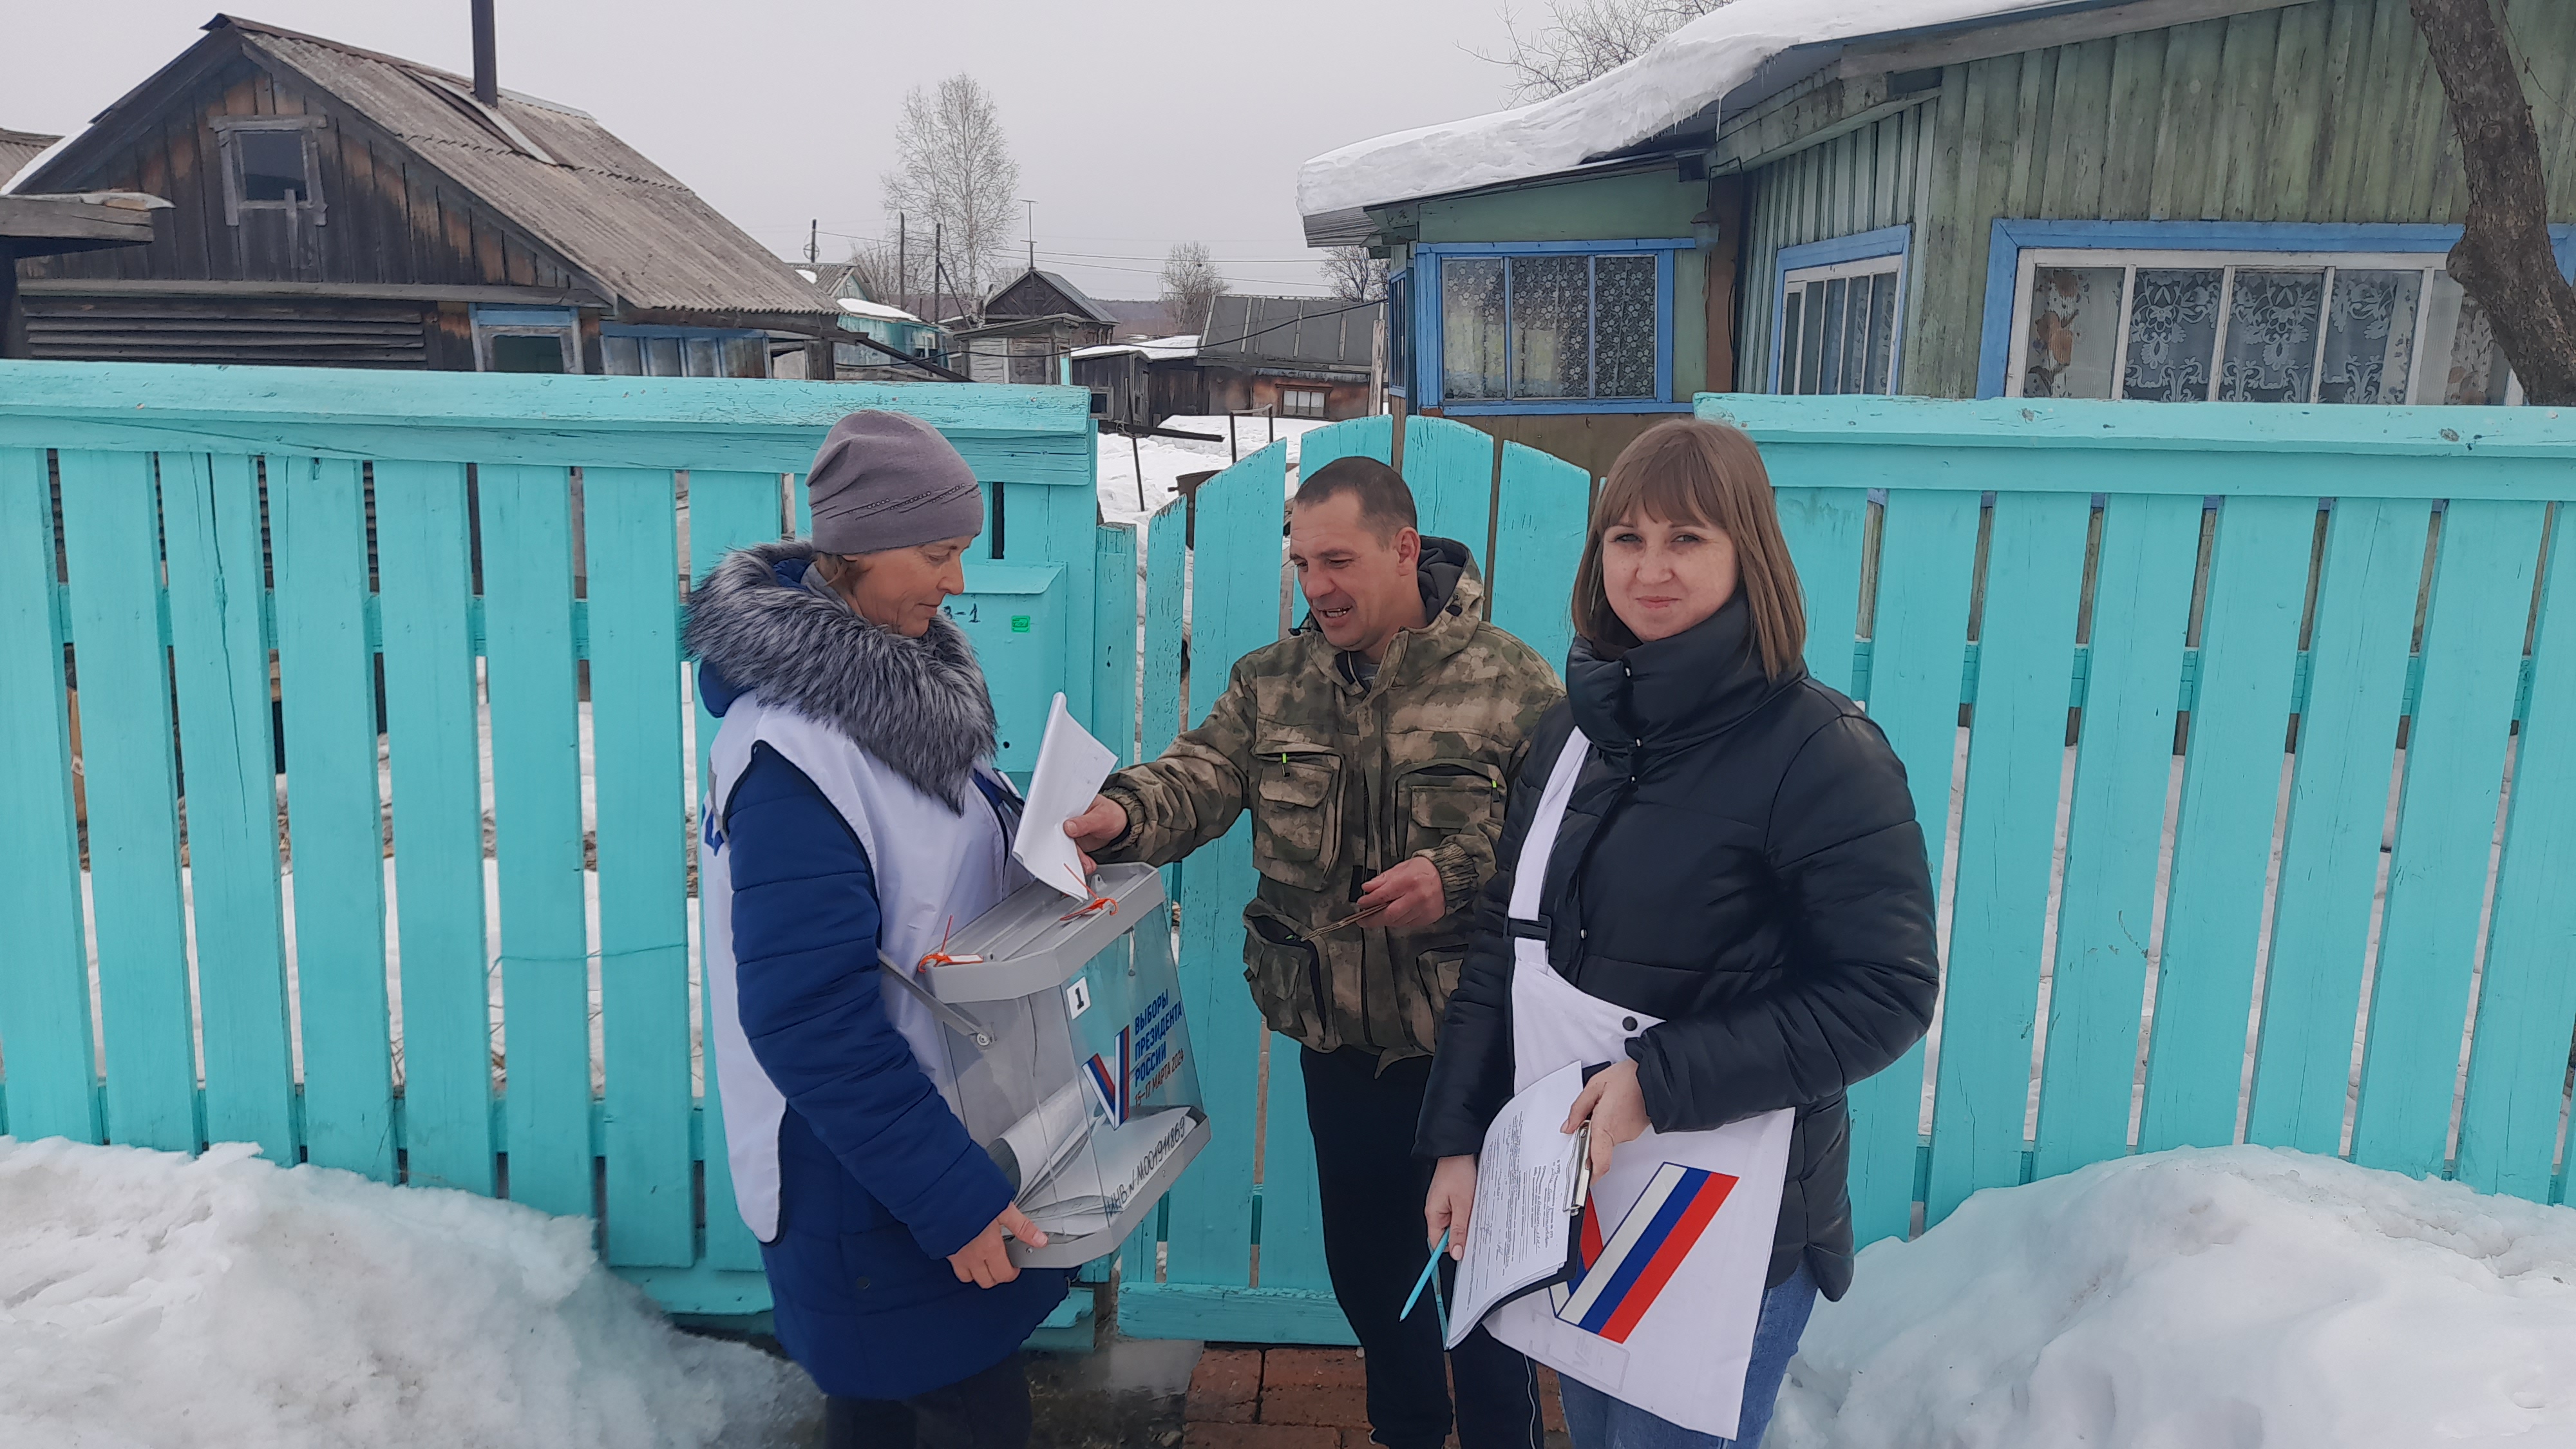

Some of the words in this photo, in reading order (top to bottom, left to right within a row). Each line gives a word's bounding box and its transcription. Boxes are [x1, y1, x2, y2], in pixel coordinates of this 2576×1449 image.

[1075, 987, 1084, 1010] 1
[1135, 988, 1168, 1036] ВЫБОРЫ
[1135, 1000, 1182, 1062] ПРЕЗИДЕНТА
[1135, 1040, 1166, 1088] РОССИИ
[1152, 1061, 1171, 1093] МАРТА
[1171, 1048, 1184, 1073] 2024
